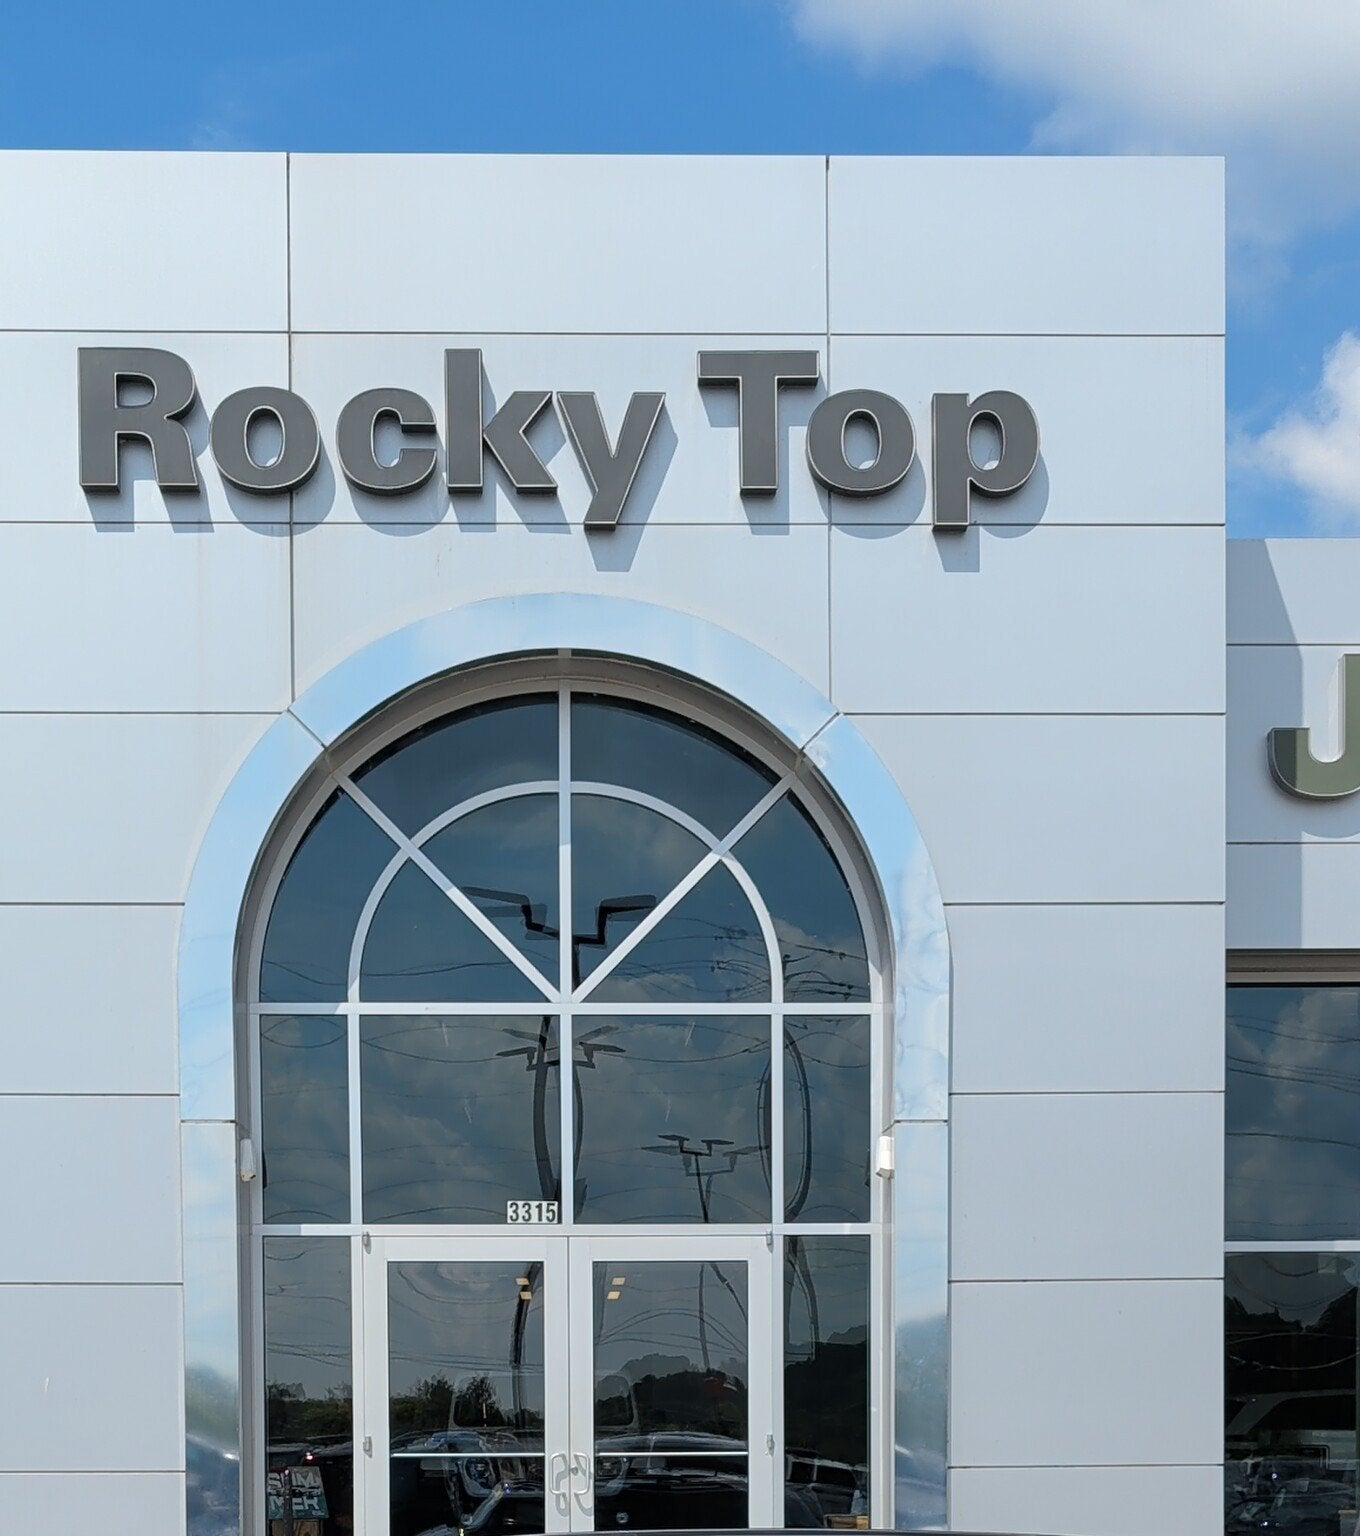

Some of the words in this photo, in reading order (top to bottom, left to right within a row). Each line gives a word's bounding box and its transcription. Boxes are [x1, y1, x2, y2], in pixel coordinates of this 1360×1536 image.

[78, 346, 666, 531] Rocky
[697, 350, 1039, 532] Top
[509, 1202, 556, 1222] 3315
